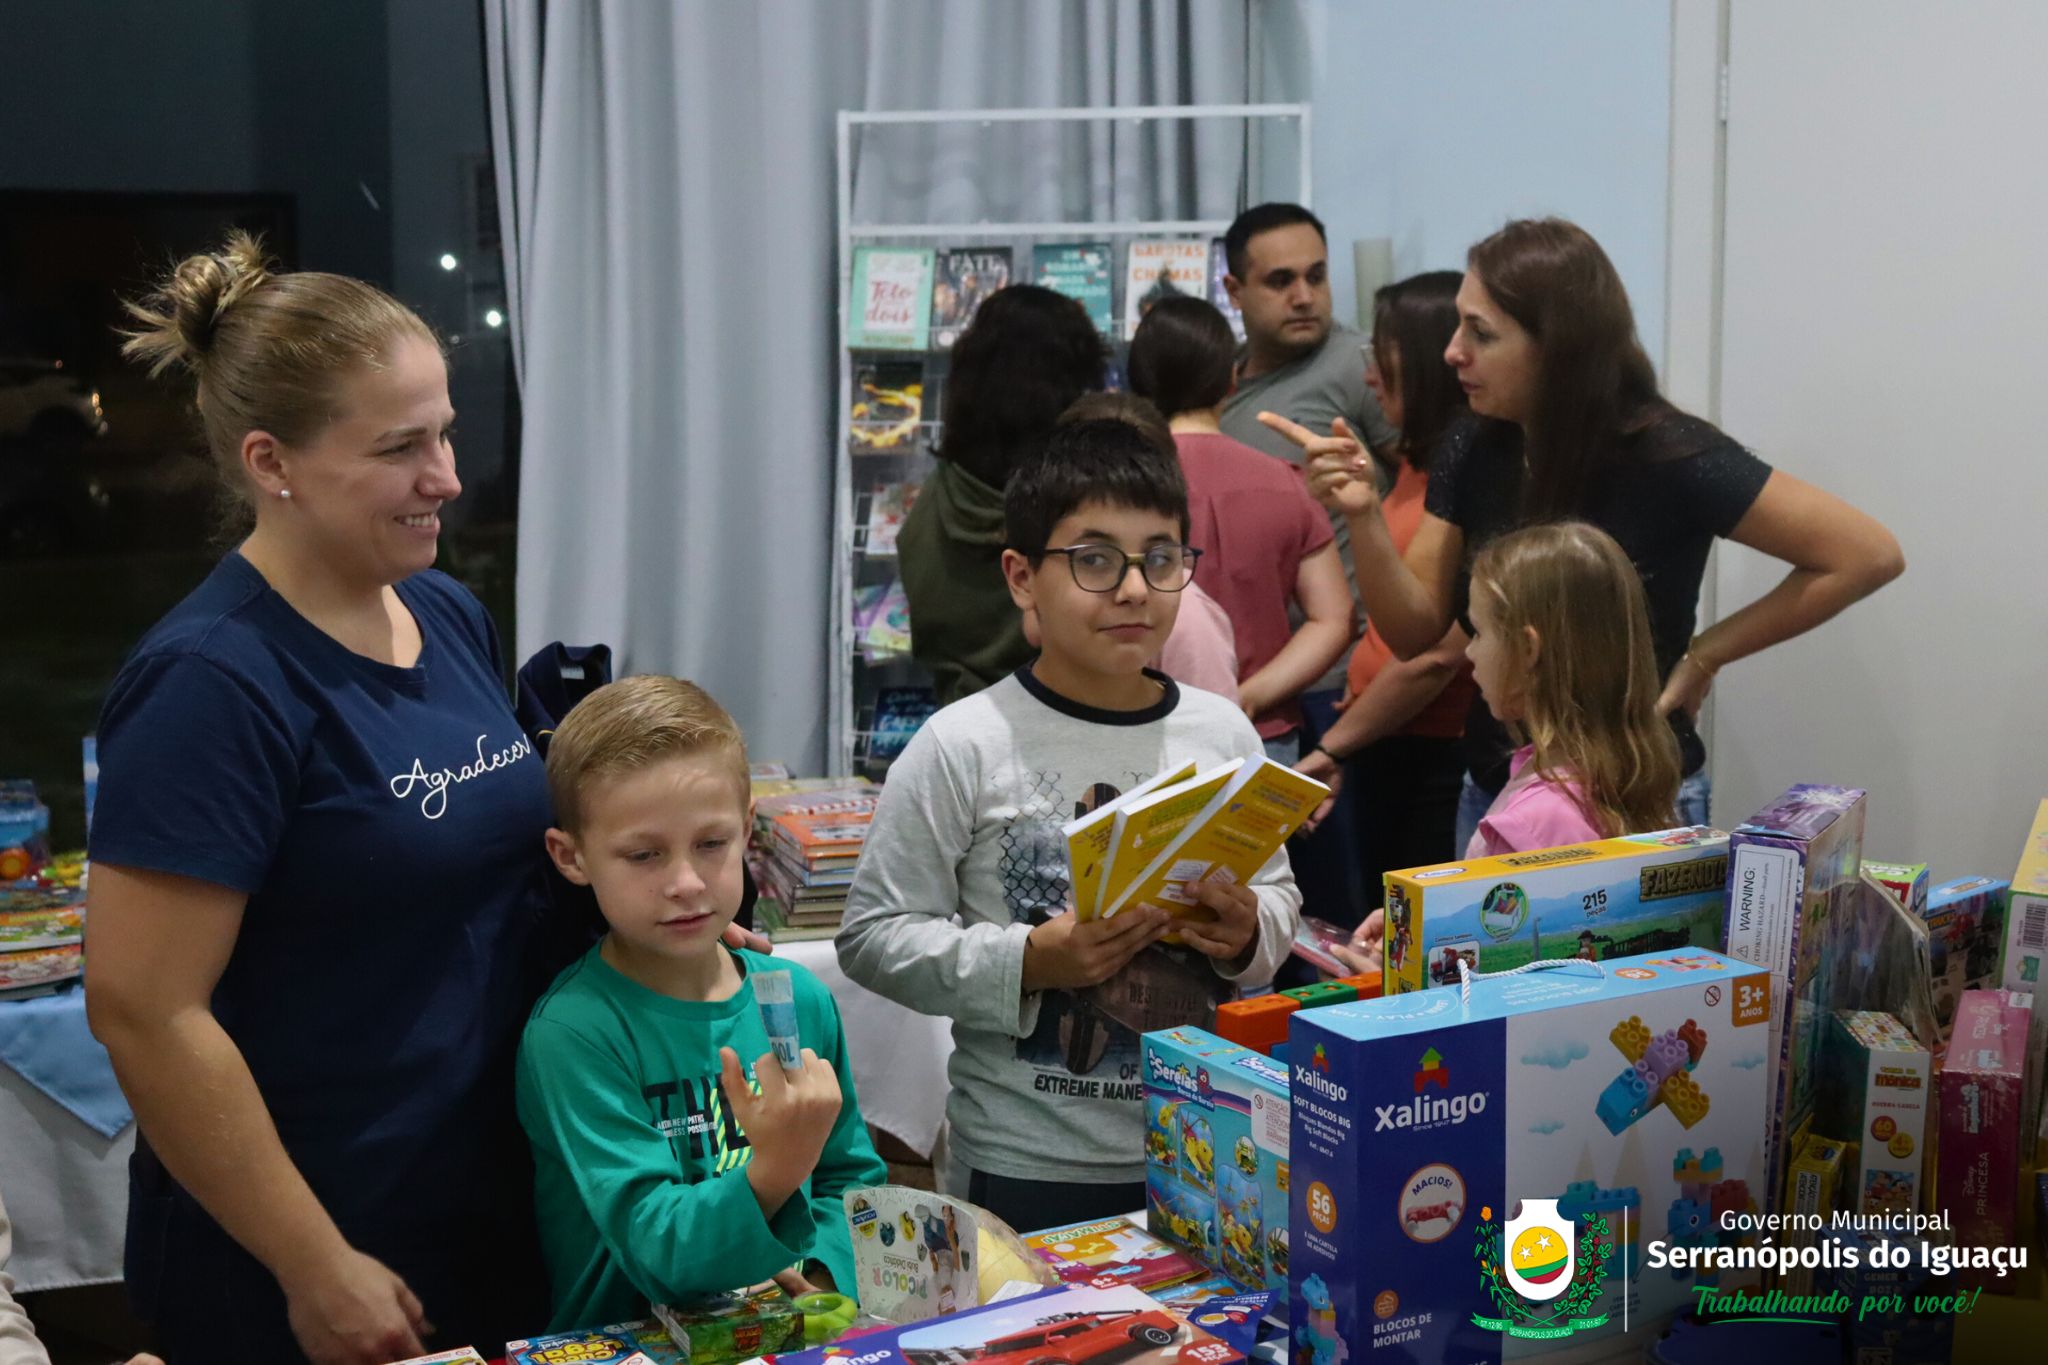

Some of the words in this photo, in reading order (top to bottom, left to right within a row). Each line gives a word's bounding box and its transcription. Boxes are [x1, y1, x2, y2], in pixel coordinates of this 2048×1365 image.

[390, 734, 532, 820] Agradecer
[1582, 889, 1608, 911] 215
[1739, 866, 1756, 932] WARNING:
[1738, 984, 1765, 1009] 3+
[1739, 1006, 1764, 1019] ANOS
[1119, 1062, 1139, 1081] OF
[1295, 1063, 1348, 1102] Xalingo
[1034, 1073, 1100, 1099] EXTREME
[1293, 1094, 1310, 1112] SOFT
[1310, 1102, 1338, 1123] BLOCOS
[1338, 1114, 1351, 1129] BIG
[1374, 1091, 1487, 1133] Xalingo
[1411, 1175, 1453, 1197] MACIOS!
[1976, 1152, 1990, 1216] PRINCESA
[1312, 1188, 1331, 1213] 56
[1312, 1209, 1331, 1226] PEÇAS
[1373, 1316, 1416, 1335] BLOCOS
[1418, 1312, 1432, 1326] DE
[1186, 1340, 1229, 1360] 153
[1373, 1329, 1422, 1349] MONTAR
